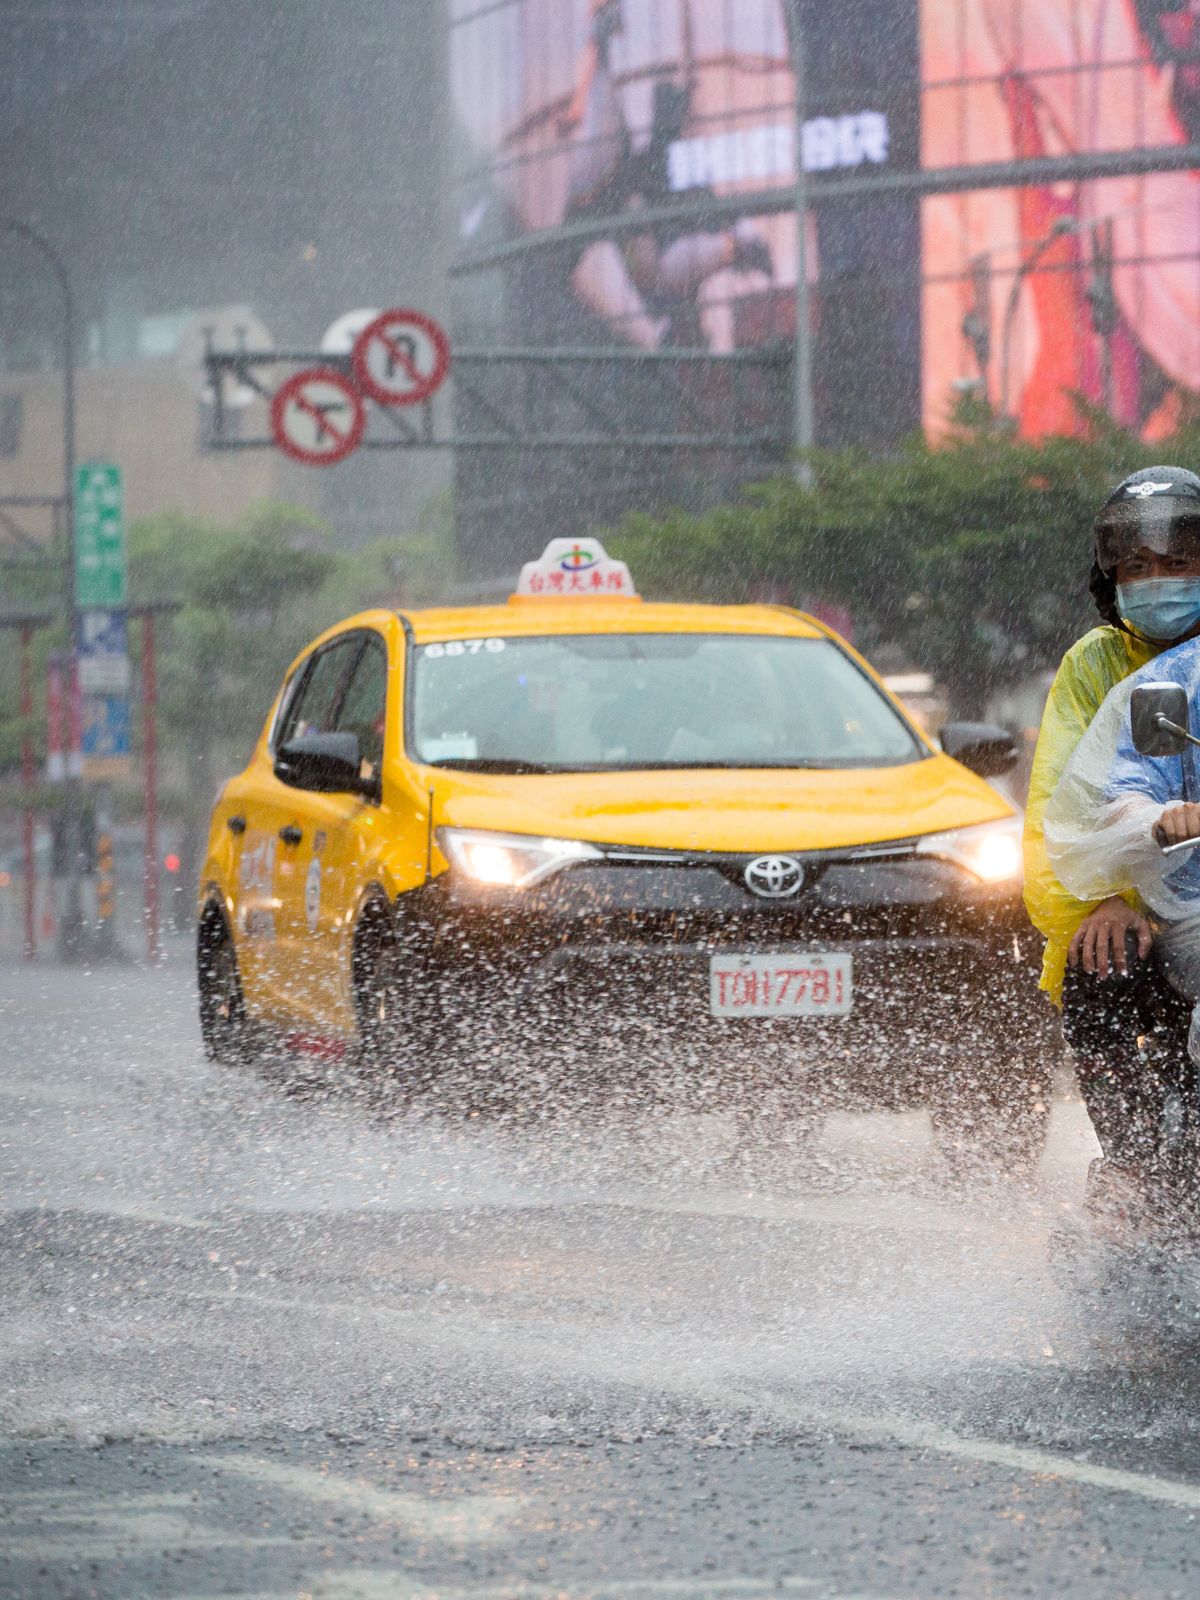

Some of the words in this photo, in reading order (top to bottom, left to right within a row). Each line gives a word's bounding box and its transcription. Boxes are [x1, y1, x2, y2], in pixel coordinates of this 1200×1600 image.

[529, 570, 625, 592] 台灣大車隊
